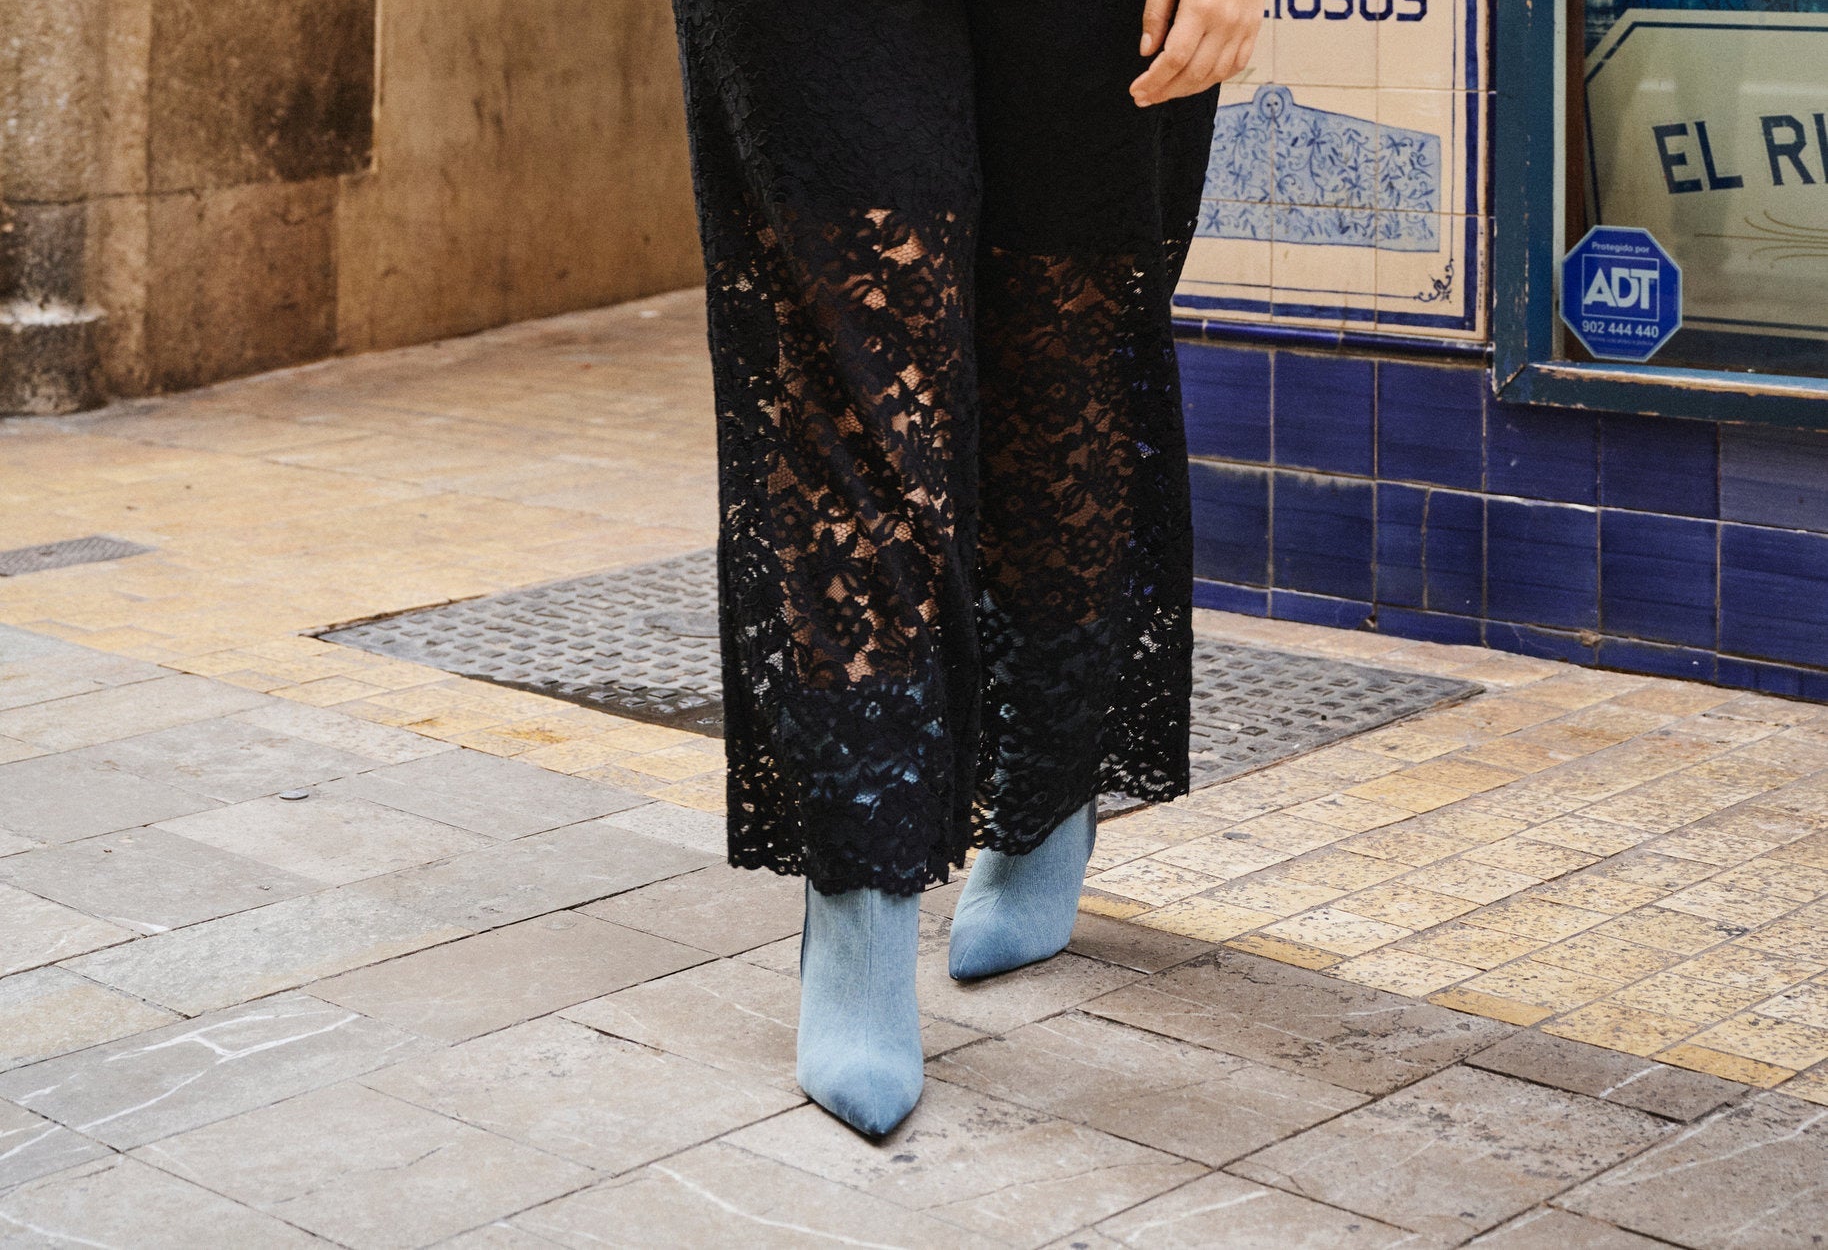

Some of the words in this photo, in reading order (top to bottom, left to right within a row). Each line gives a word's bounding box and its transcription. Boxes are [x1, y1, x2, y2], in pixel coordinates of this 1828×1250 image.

[1652, 120, 1744, 194] EL
[1591, 241, 1633, 254] Protegido
[1635, 246, 1650, 254] por
[1583, 267, 1659, 310] ADT
[1582, 320, 1605, 334] 902
[1608, 322, 1632, 336] 444
[1635, 324, 1659, 338] 440
